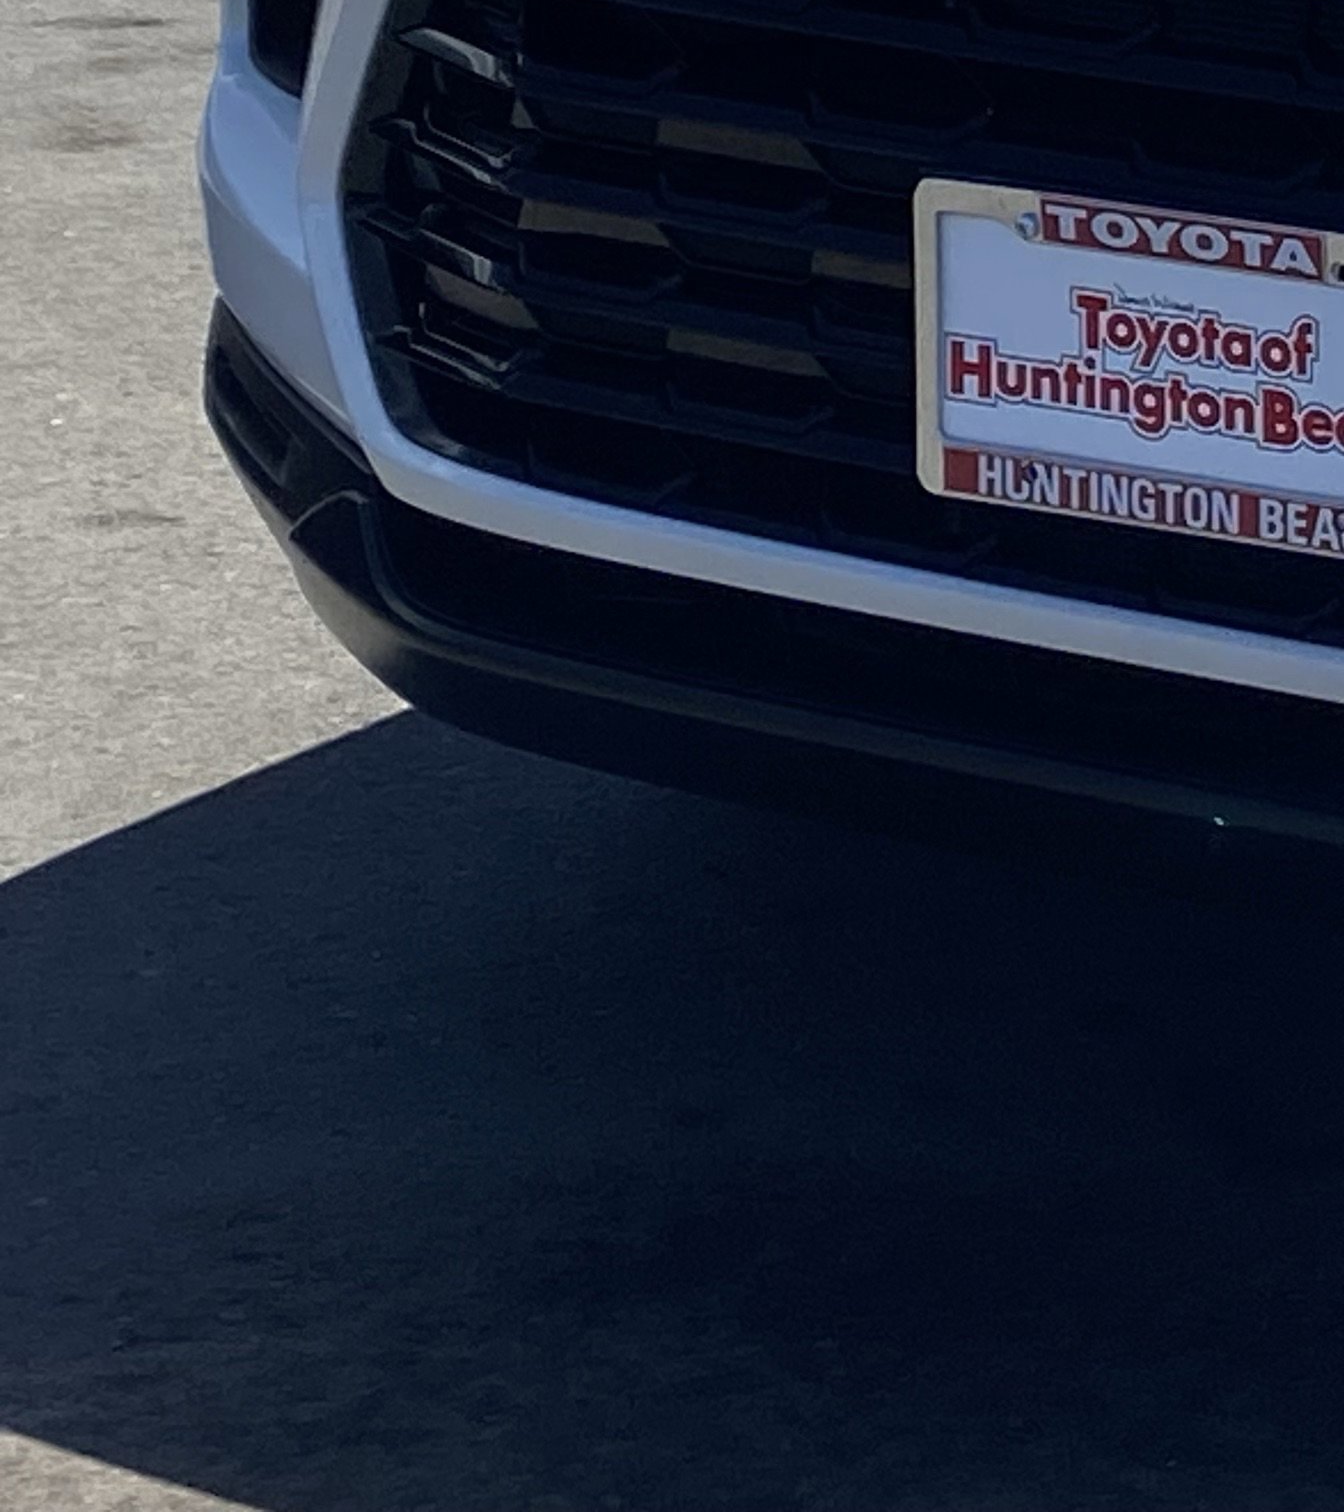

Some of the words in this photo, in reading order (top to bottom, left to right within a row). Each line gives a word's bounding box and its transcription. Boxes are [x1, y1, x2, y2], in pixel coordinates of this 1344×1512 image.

[1045, 203, 1317, 277] TOYOTA
[1075, 293, 1252, 368] Toyota
[1260, 321, 1313, 376] of
[949, 340, 1256, 434] Huntington
[977, 455, 1240, 536] HUNTINGTON
